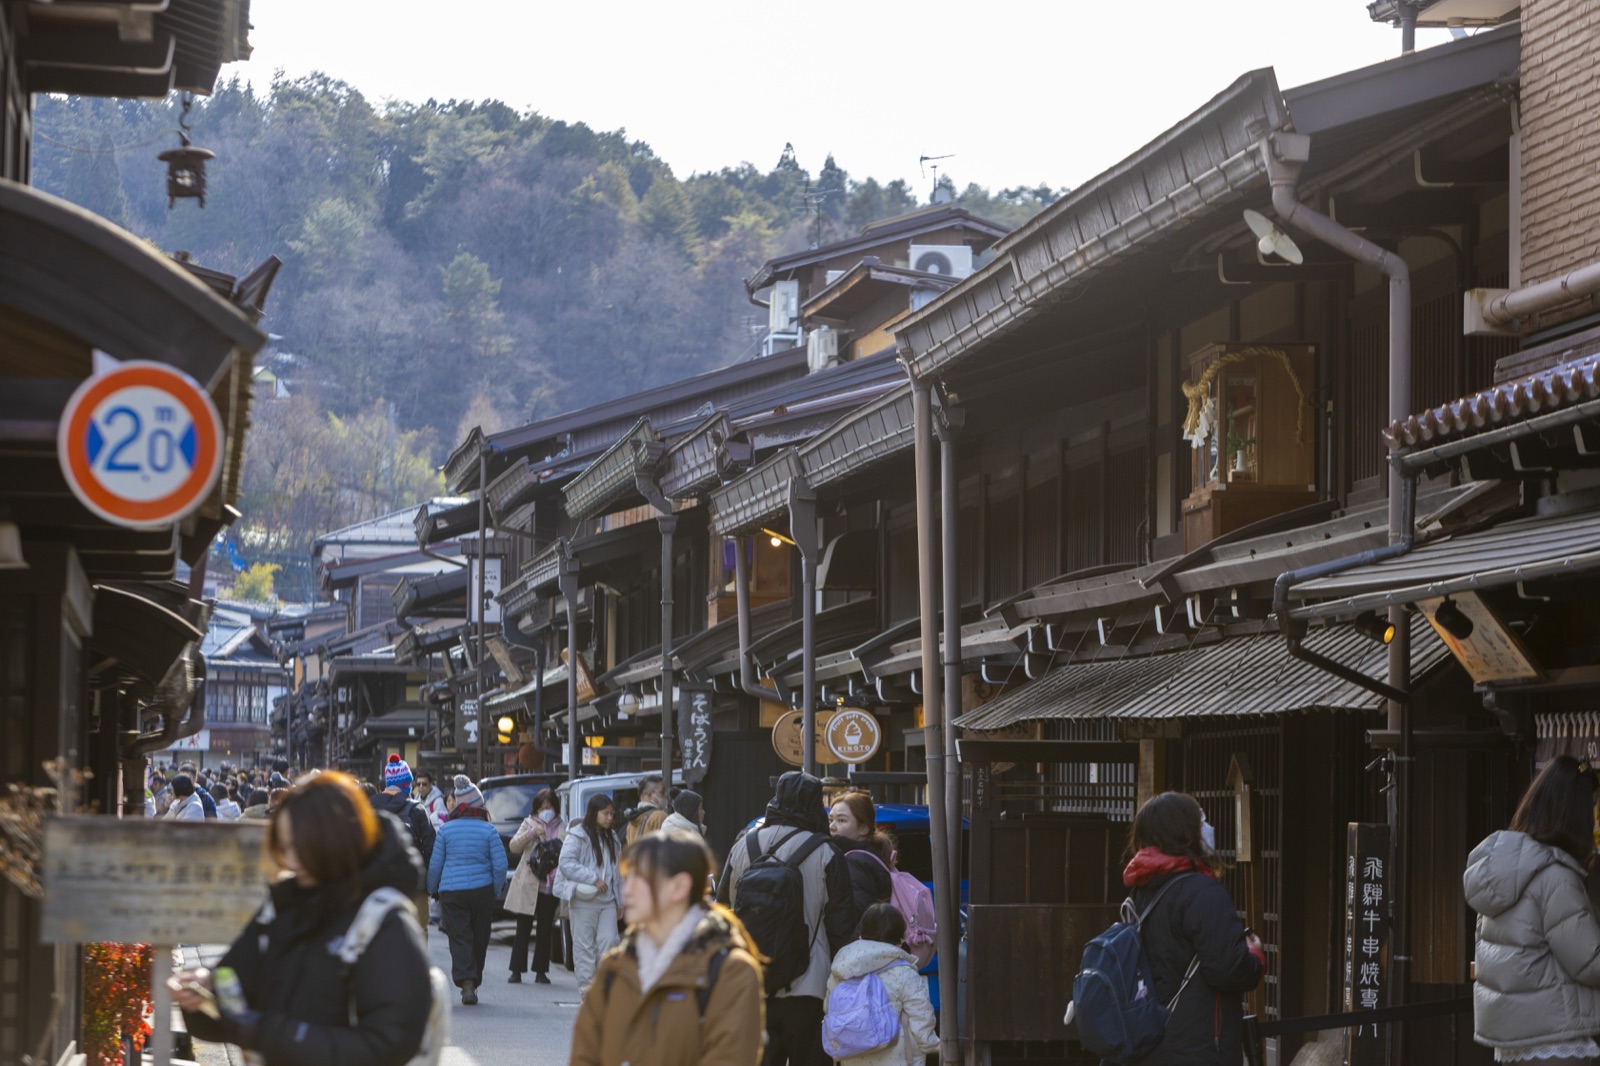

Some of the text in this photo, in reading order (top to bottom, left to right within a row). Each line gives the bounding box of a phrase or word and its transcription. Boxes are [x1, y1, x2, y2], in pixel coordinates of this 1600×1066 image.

[690, 693, 711, 768] そばうどん
[837, 744, 871, 752] KINOTO
